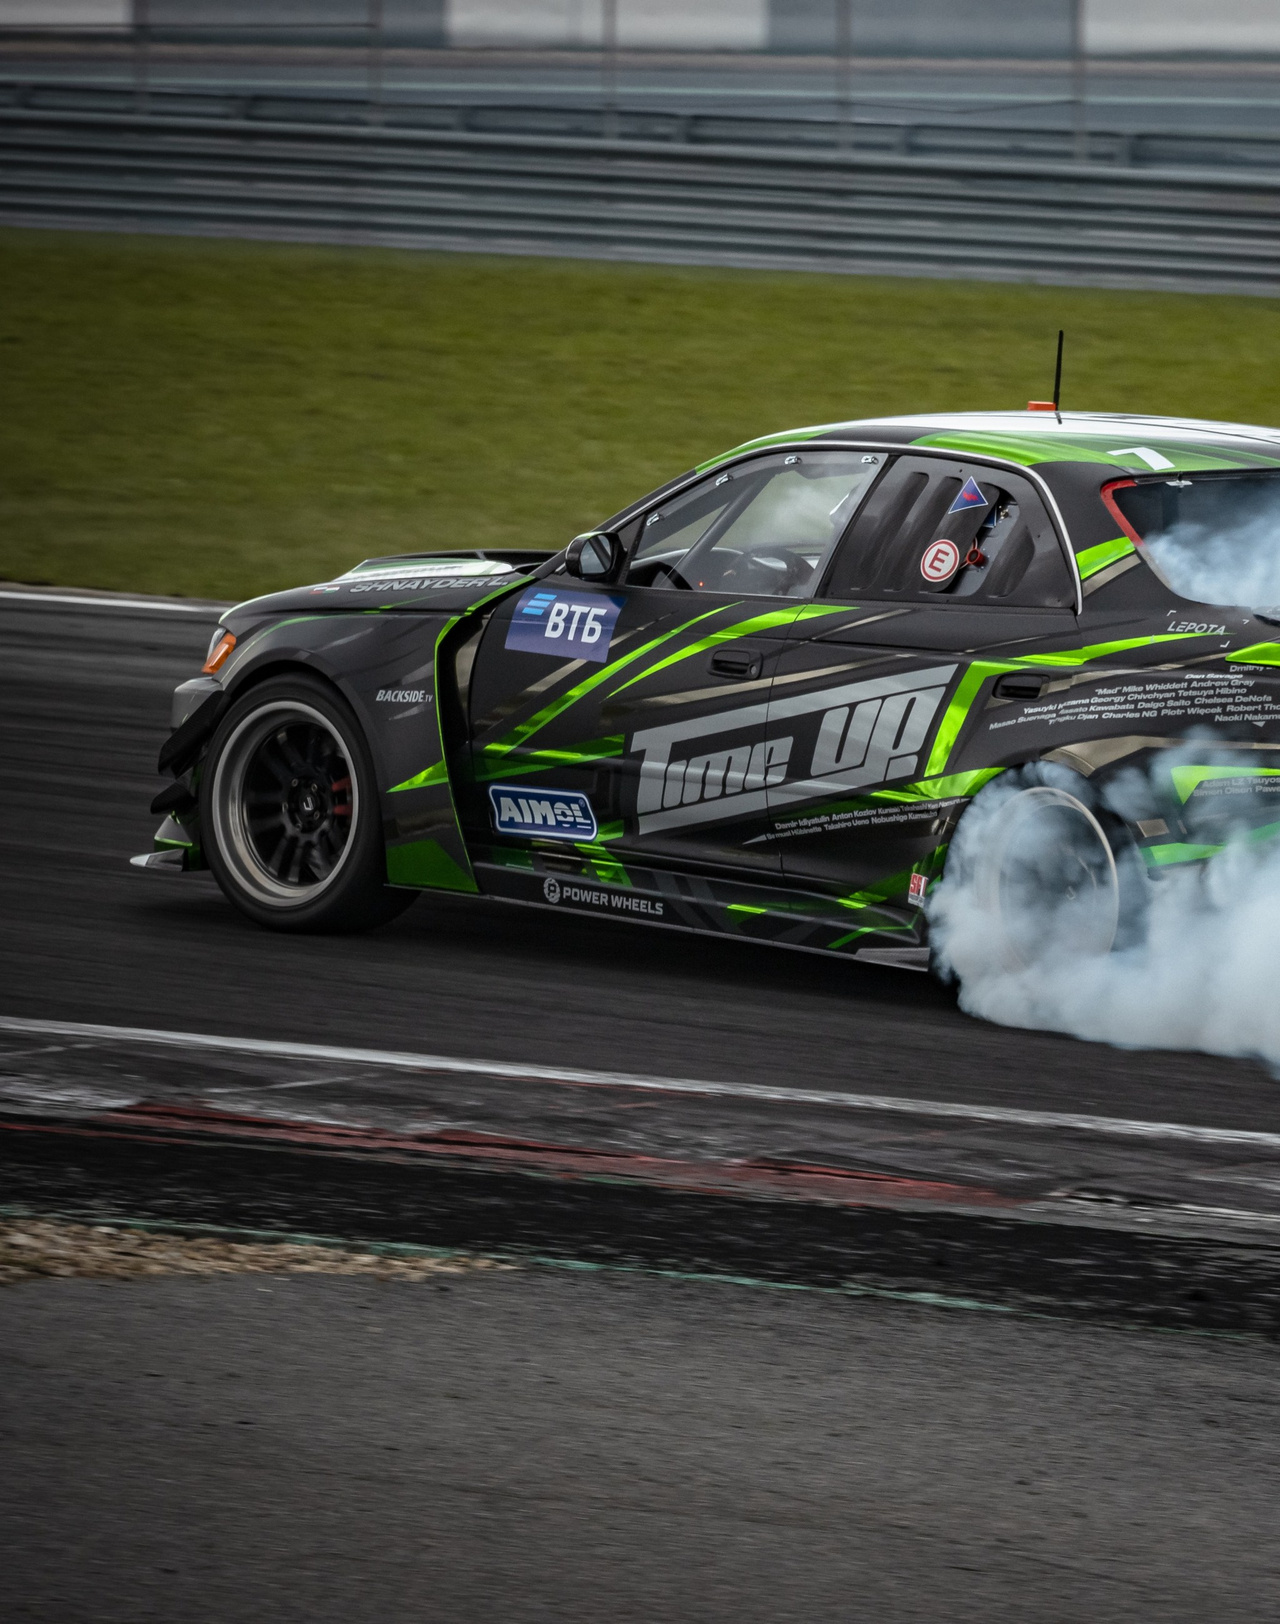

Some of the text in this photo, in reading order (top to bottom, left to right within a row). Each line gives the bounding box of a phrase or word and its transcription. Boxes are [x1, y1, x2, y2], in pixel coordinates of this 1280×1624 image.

[928, 548, 950, 572] E
[350, 578, 489, 593] SHNAYDER
[544, 603, 607, 644] ВТБ
[1166, 621, 1226, 635] LEPOTA
[1122, 683, 1144, 693] Mike
[1145, 682, 1188, 691] Whiddett
[1190, 680, 1229, 688] Andrew
[1230, 679, 1255, 687] Gray
[1090, 696, 1125, 704] Georgy
[1127, 692, 1176, 701] Chivchyan
[1177, 689, 1214, 697] Tetsuya
[1215, 687, 1247, 695] Hibino
[989, 718, 1017, 731] Masao
[1017, 713, 1057, 724] Suenaga
[1088, 703, 1135, 713] Kawabata
[1137, 701, 1165, 709] Daigo
[1166, 699, 1191, 707] Saito
[1194, 697, 1234, 705] Chelsea
[1234, 694, 1273, 703] DeNofa
[1048, 713, 1077, 726] Tngku
[1076, 712, 1099, 721] Djan
[1102, 710, 1141, 719] Charles
[1142, 709, 1158, 718] NG
[1160, 708, 1186, 717] Piotr
[1226, 703, 1263, 713] Robert
[1214, 714, 1243, 722] Naoki
[832, 812, 853, 821] Anton
[853, 808, 877, 818] Kozlov
[852, 818, 870, 827] Ueno
[563, 886, 609, 906] POWER
[611, 893, 664, 916] WHEELS
